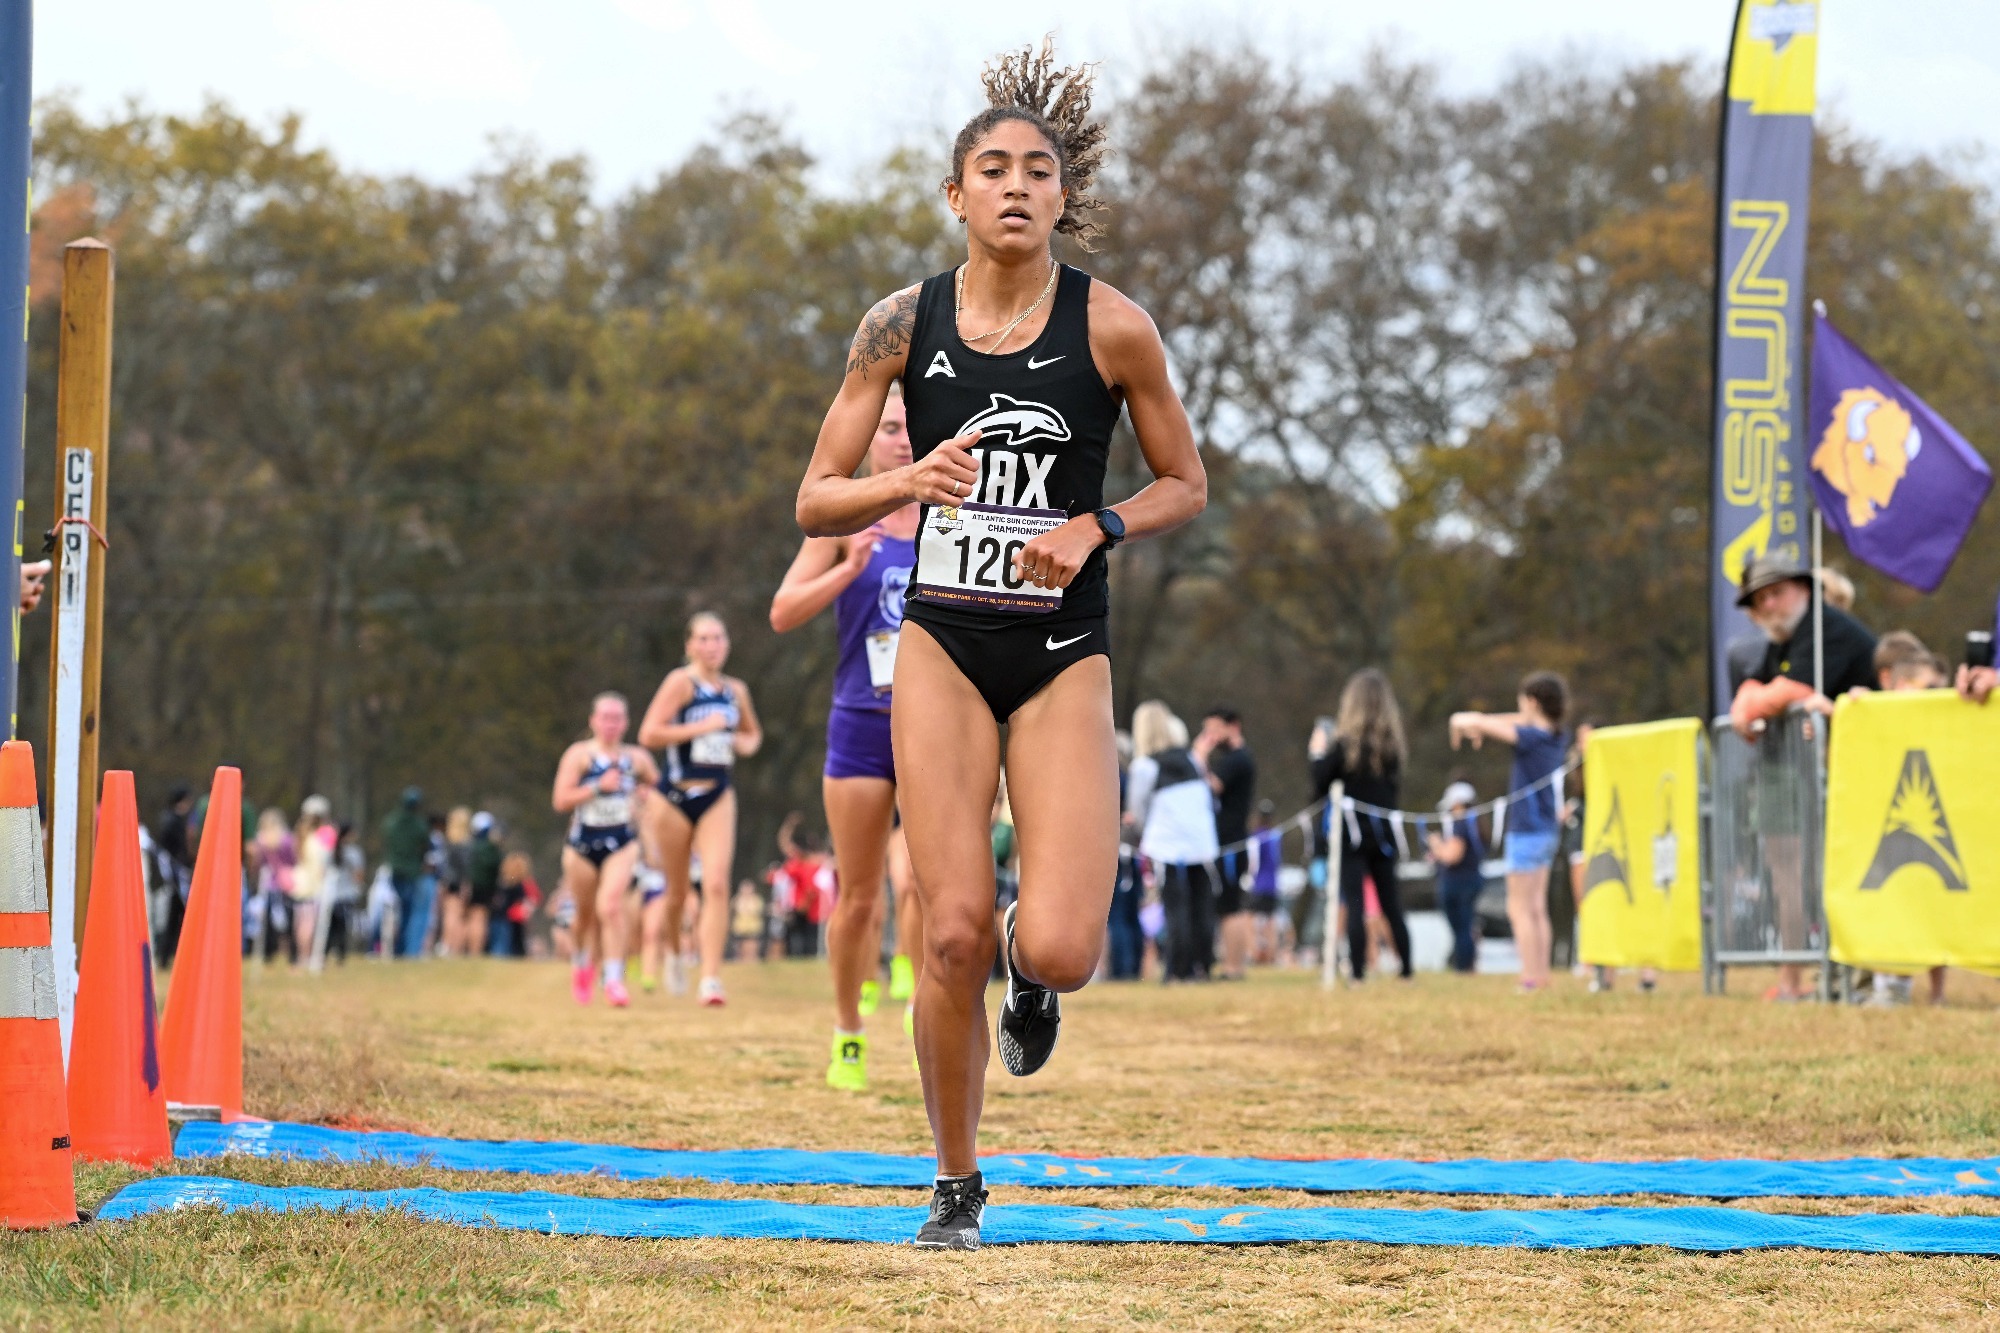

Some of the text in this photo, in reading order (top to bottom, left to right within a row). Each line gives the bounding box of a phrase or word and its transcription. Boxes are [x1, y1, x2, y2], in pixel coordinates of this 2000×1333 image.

[1722, 200, 1790, 586] ASUN
[971, 513, 1006, 524] ATLANTIC
[1006, 517, 1021, 525] SUN
[987, 524, 1051, 536] CHAMPIONSHI
